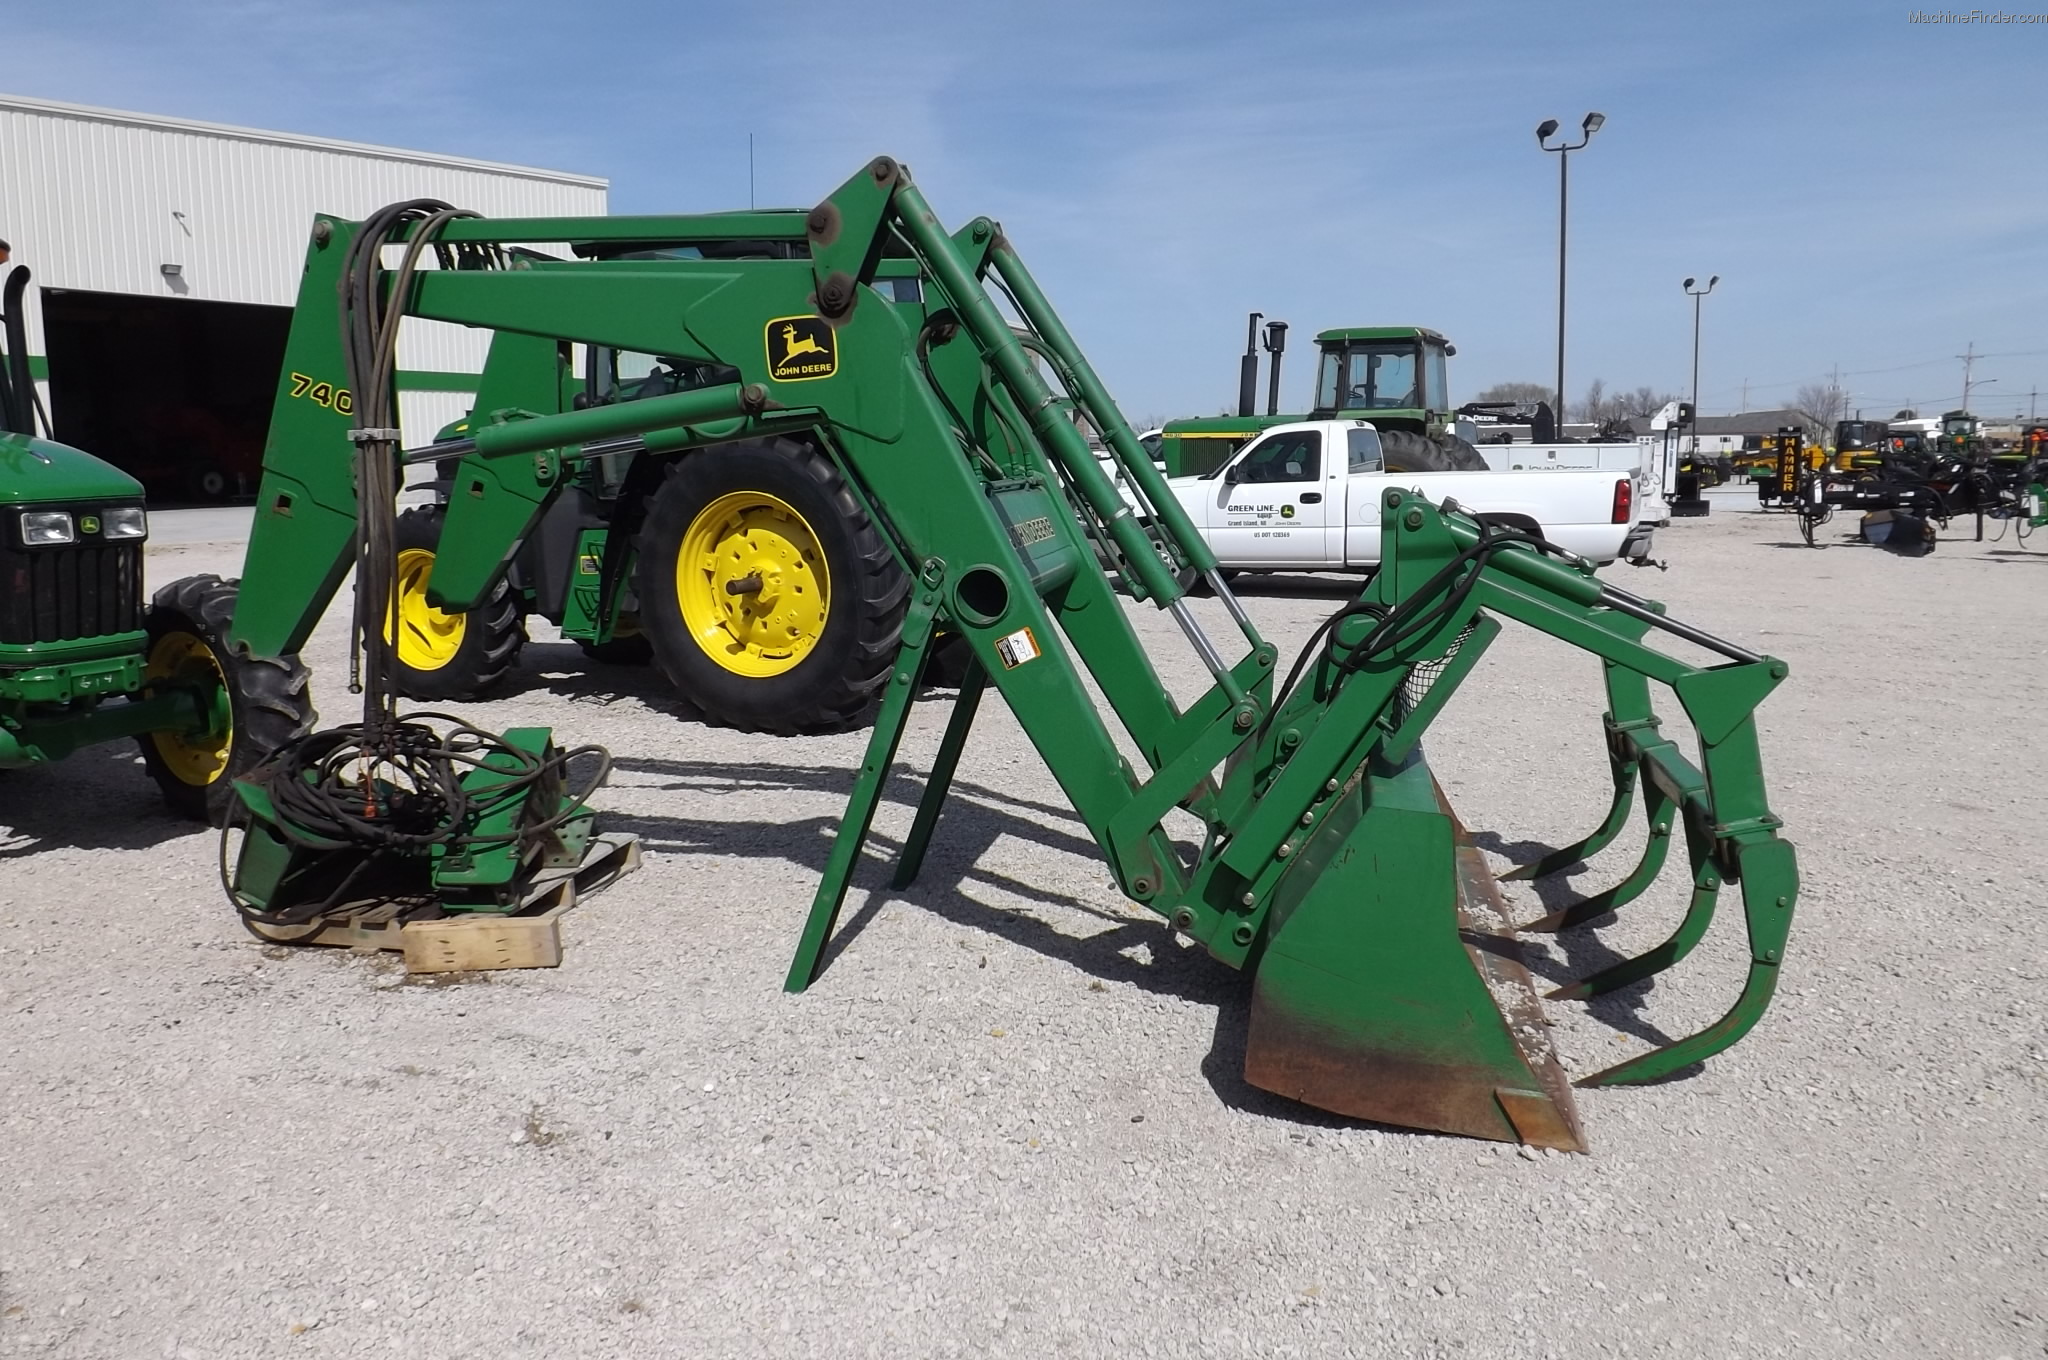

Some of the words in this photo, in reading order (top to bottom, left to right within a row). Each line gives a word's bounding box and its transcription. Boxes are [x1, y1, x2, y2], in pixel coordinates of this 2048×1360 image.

[774, 366, 800, 377] JOHN
[801, 363, 832, 374] DEERE
[290, 371, 354, 416] 740
[1473, 414, 1498, 422] DEERE
[1783, 437, 1796, 492] HAMMER
[1026, 516, 1056, 542] DEERE
